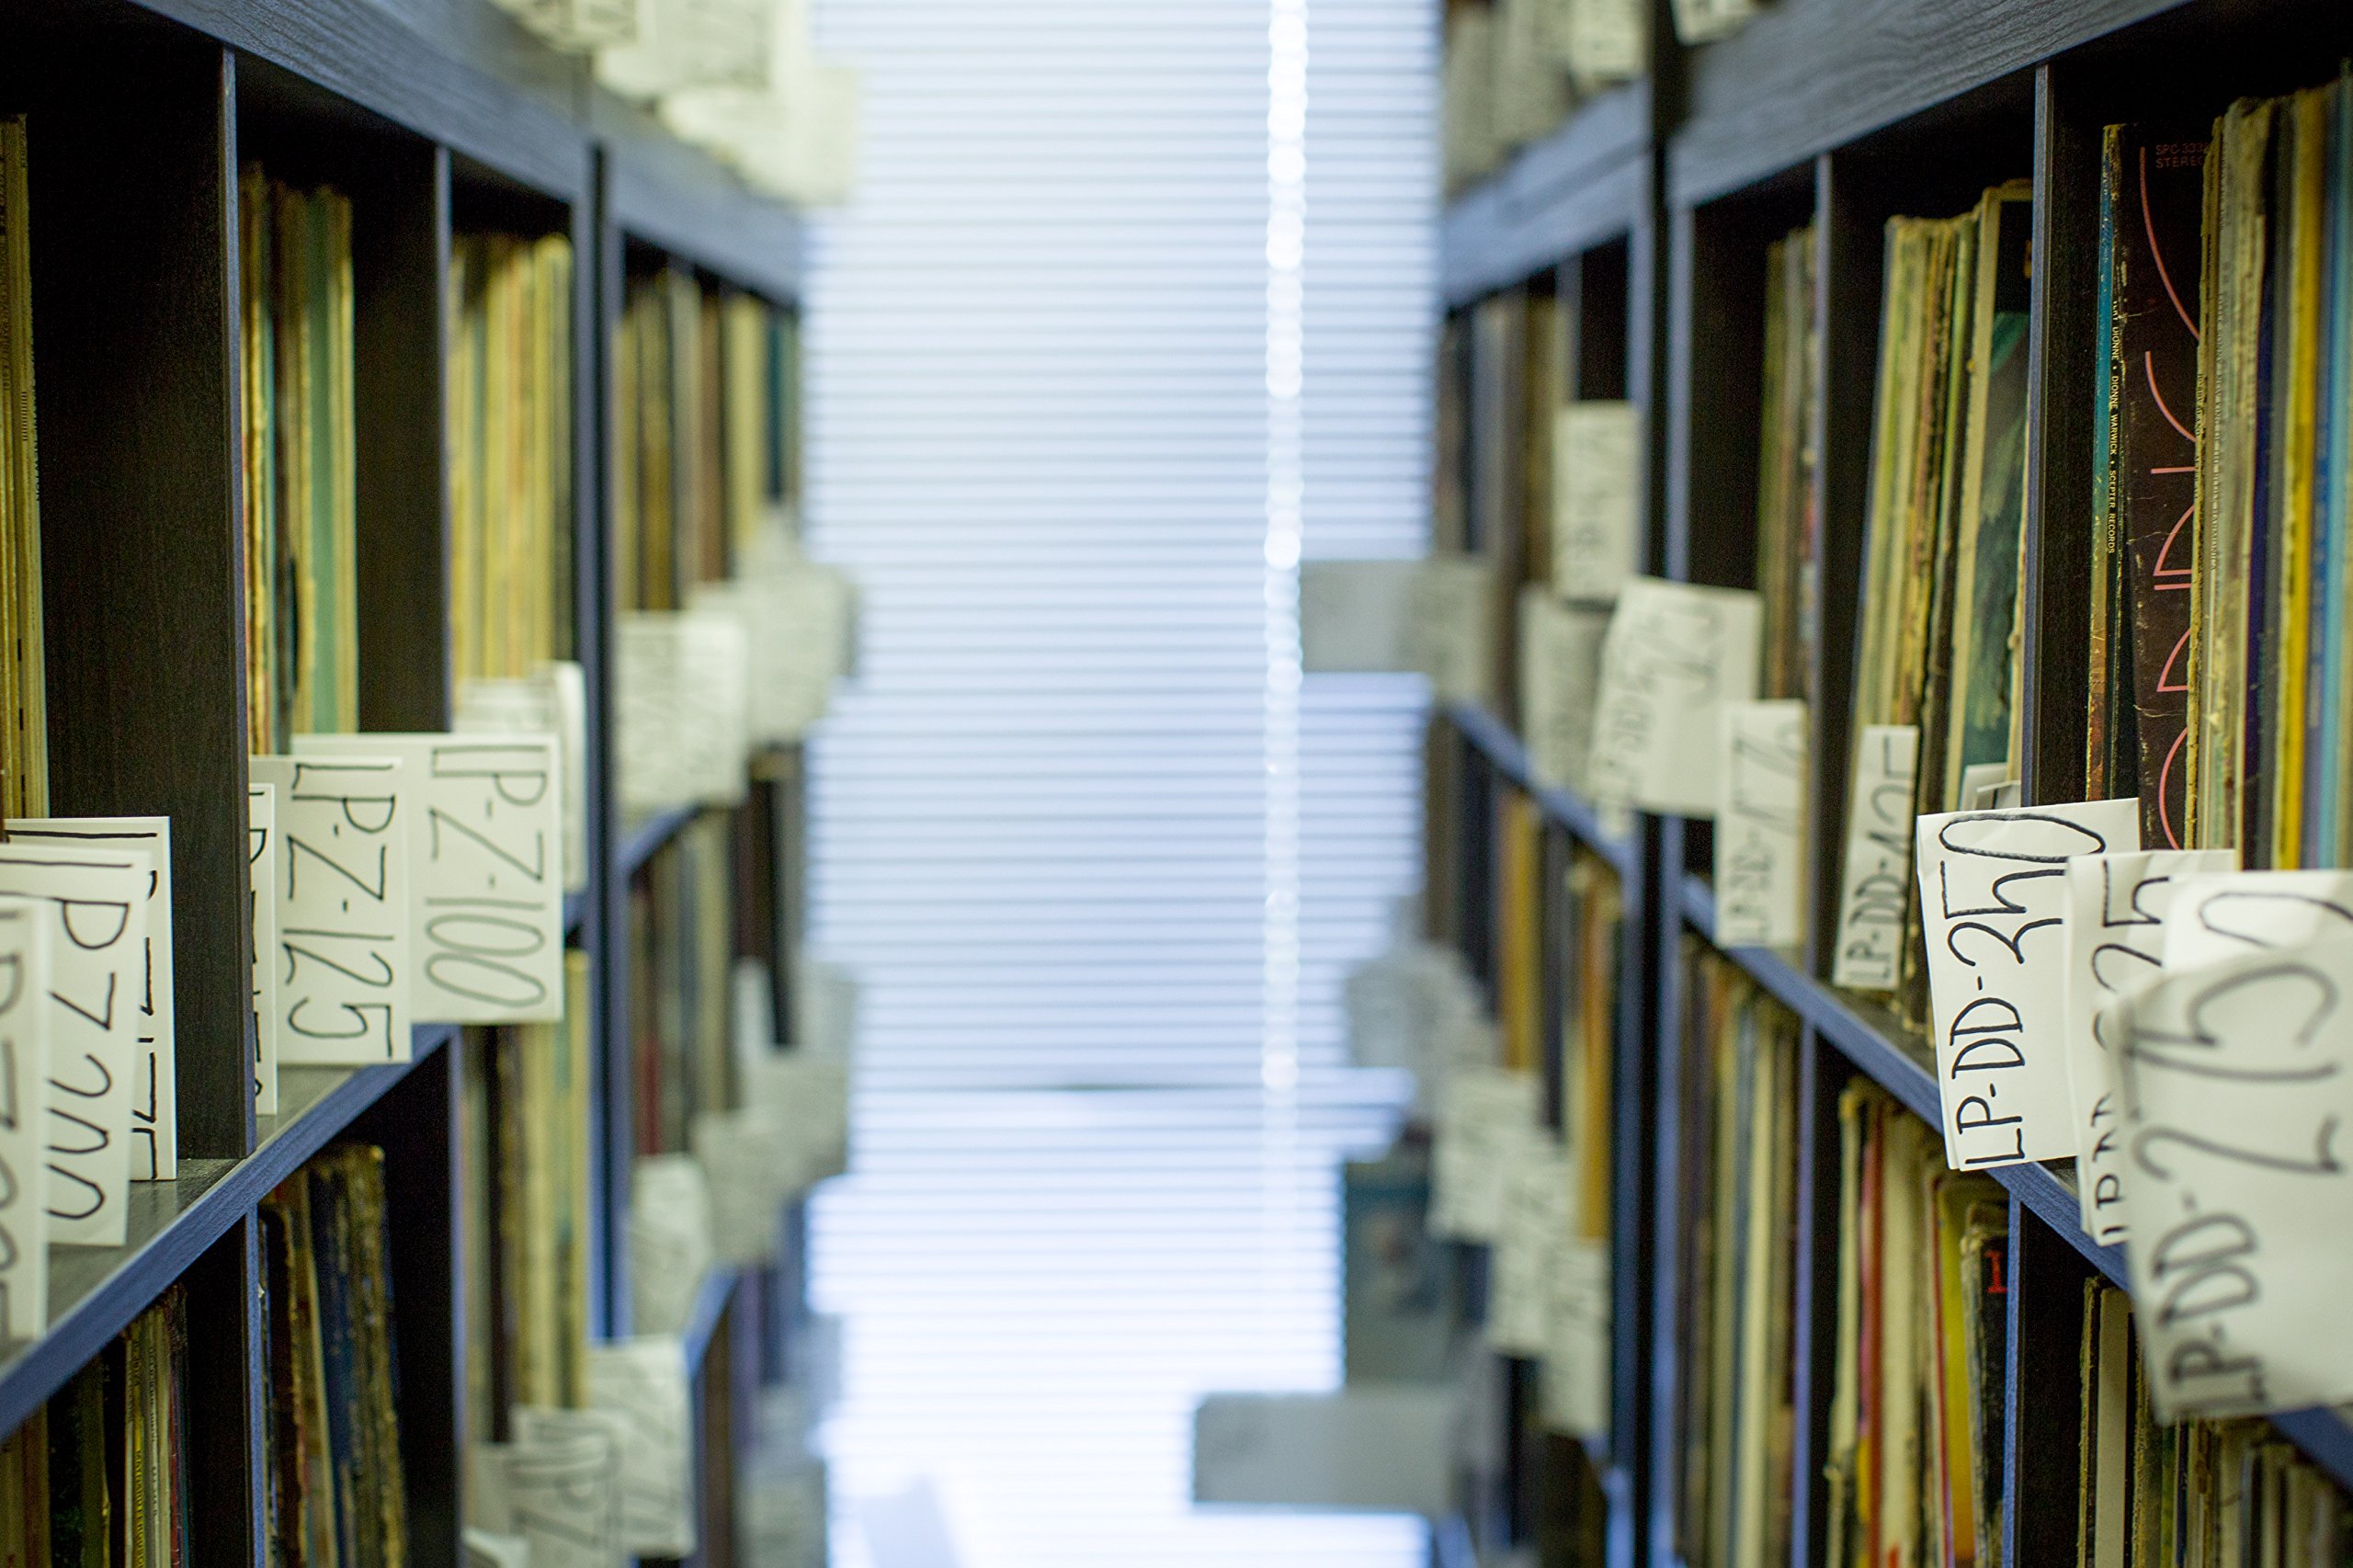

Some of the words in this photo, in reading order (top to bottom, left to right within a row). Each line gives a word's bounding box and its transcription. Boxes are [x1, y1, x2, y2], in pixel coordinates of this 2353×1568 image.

[2111, 326, 2120, 360] DIONNE
[2110, 376, 2120, 410] DIONNE
[2109, 414, 2119, 455] WARWICK
[2109, 470, 2117, 508] SCEPTER
[2108, 514, 2116, 554] RECORDS
[425, 745, 548, 1009] LP-Z-100
[283, 763, 396, 1059] LP-Z-125
[1939, 812, 2105, 1165] LP-DD-350
[2123, 960, 2337, 1404] LP-DD-275
